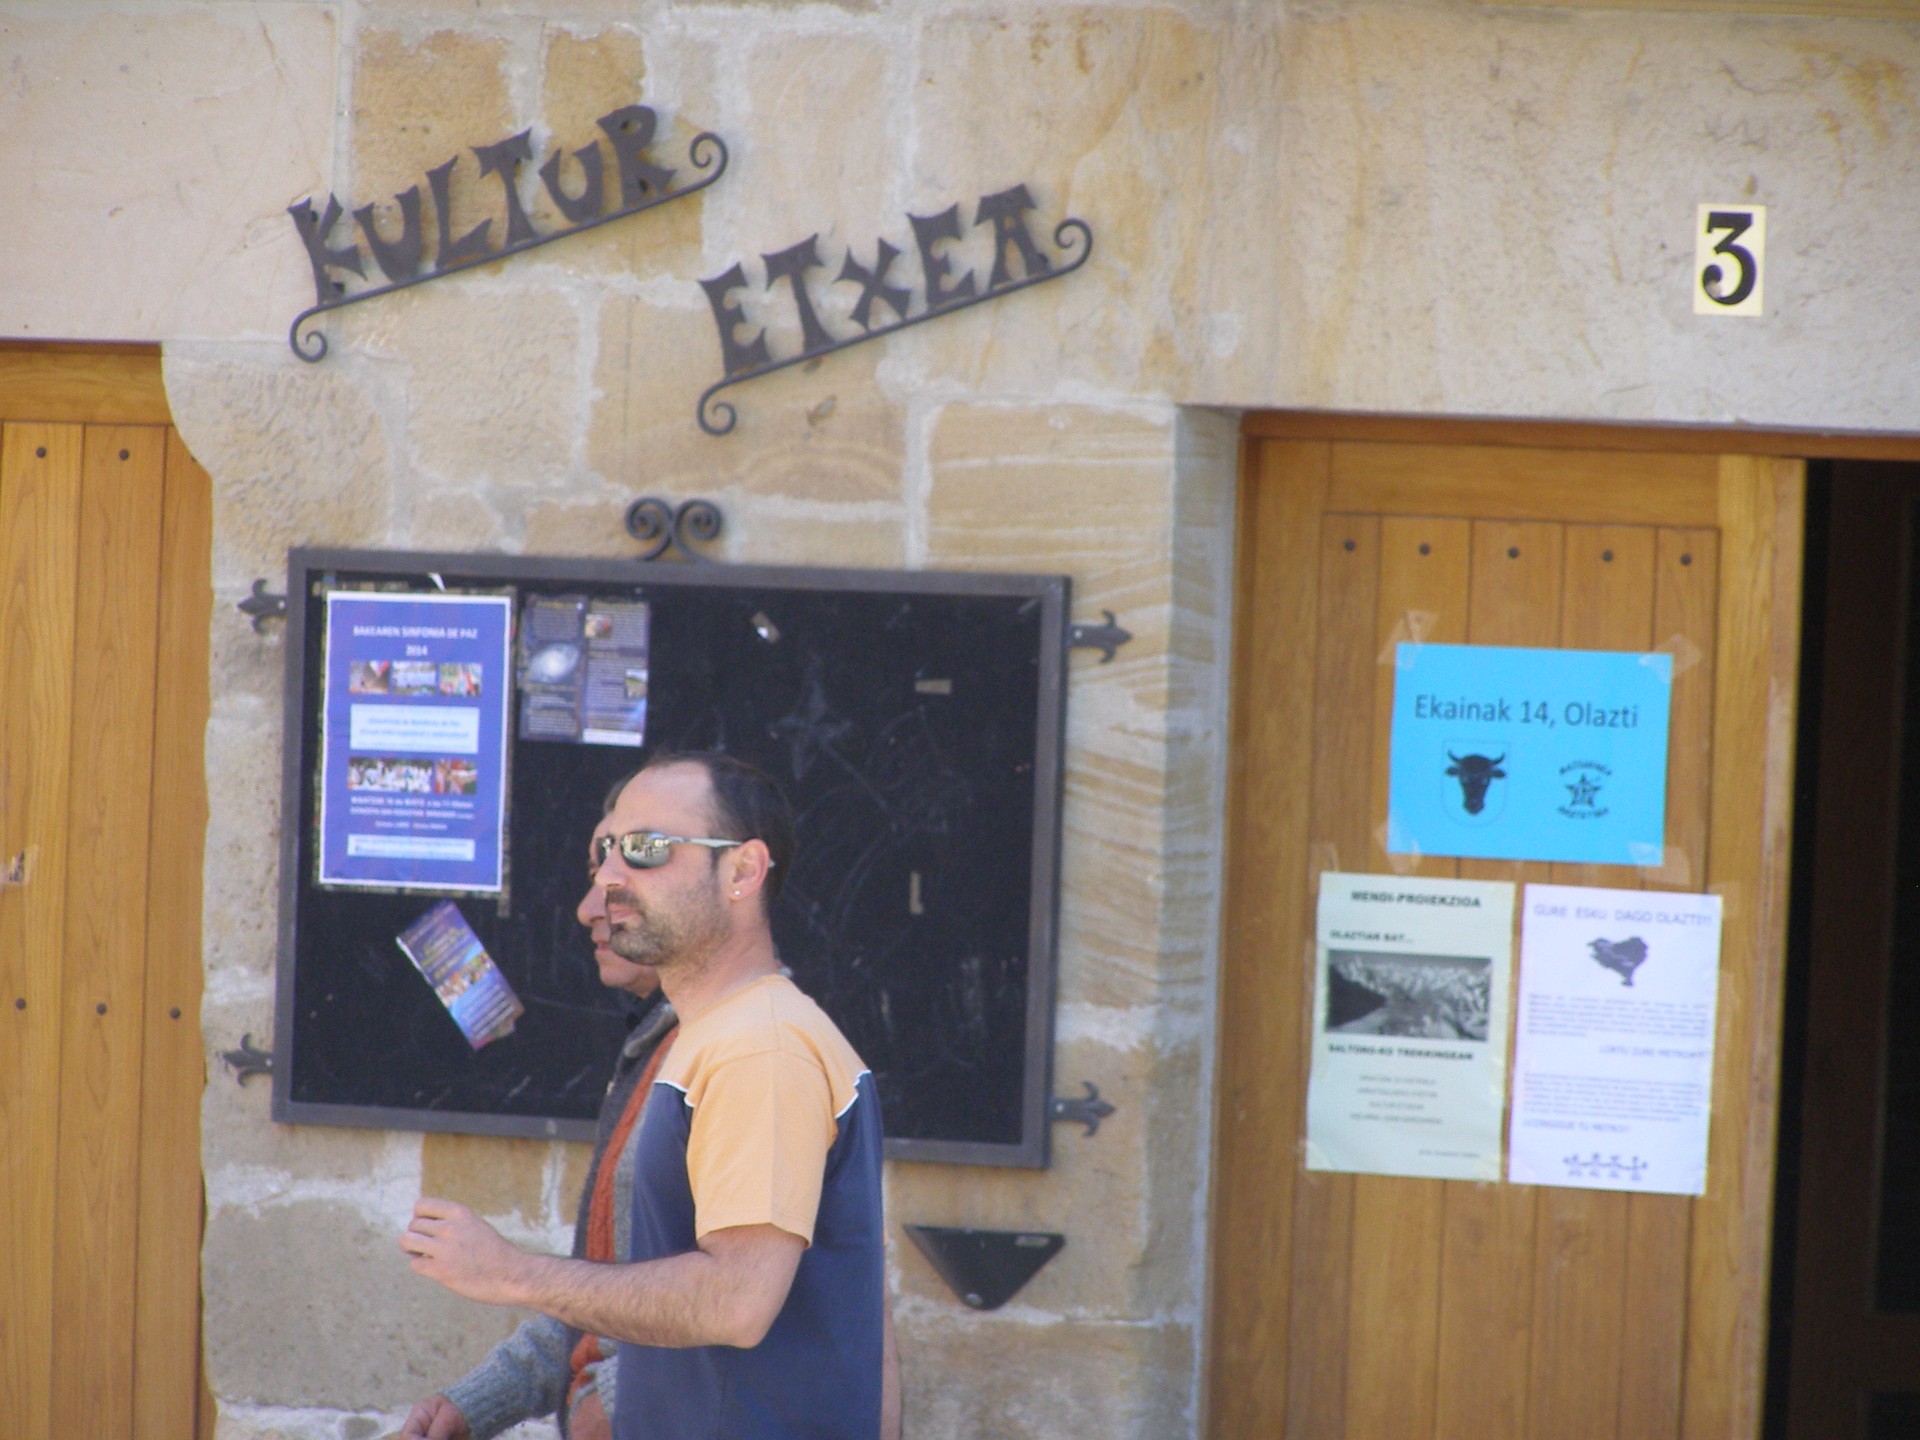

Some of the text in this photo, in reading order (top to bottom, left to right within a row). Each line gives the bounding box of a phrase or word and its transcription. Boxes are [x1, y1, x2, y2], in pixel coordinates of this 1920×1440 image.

[288, 104, 677, 306] KULTUR
[698, 183, 1057, 378] ETXEA
[1702, 211, 1756, 305] 3
[460, 628, 478, 639] PAZ
[1414, 694, 1639, 729] Ekainak 14, Olazti
[1533, 904, 1567, 918] GURE
[1575, 906, 1607, 920] ESKU
[1614, 908, 1652, 922] DAGO
